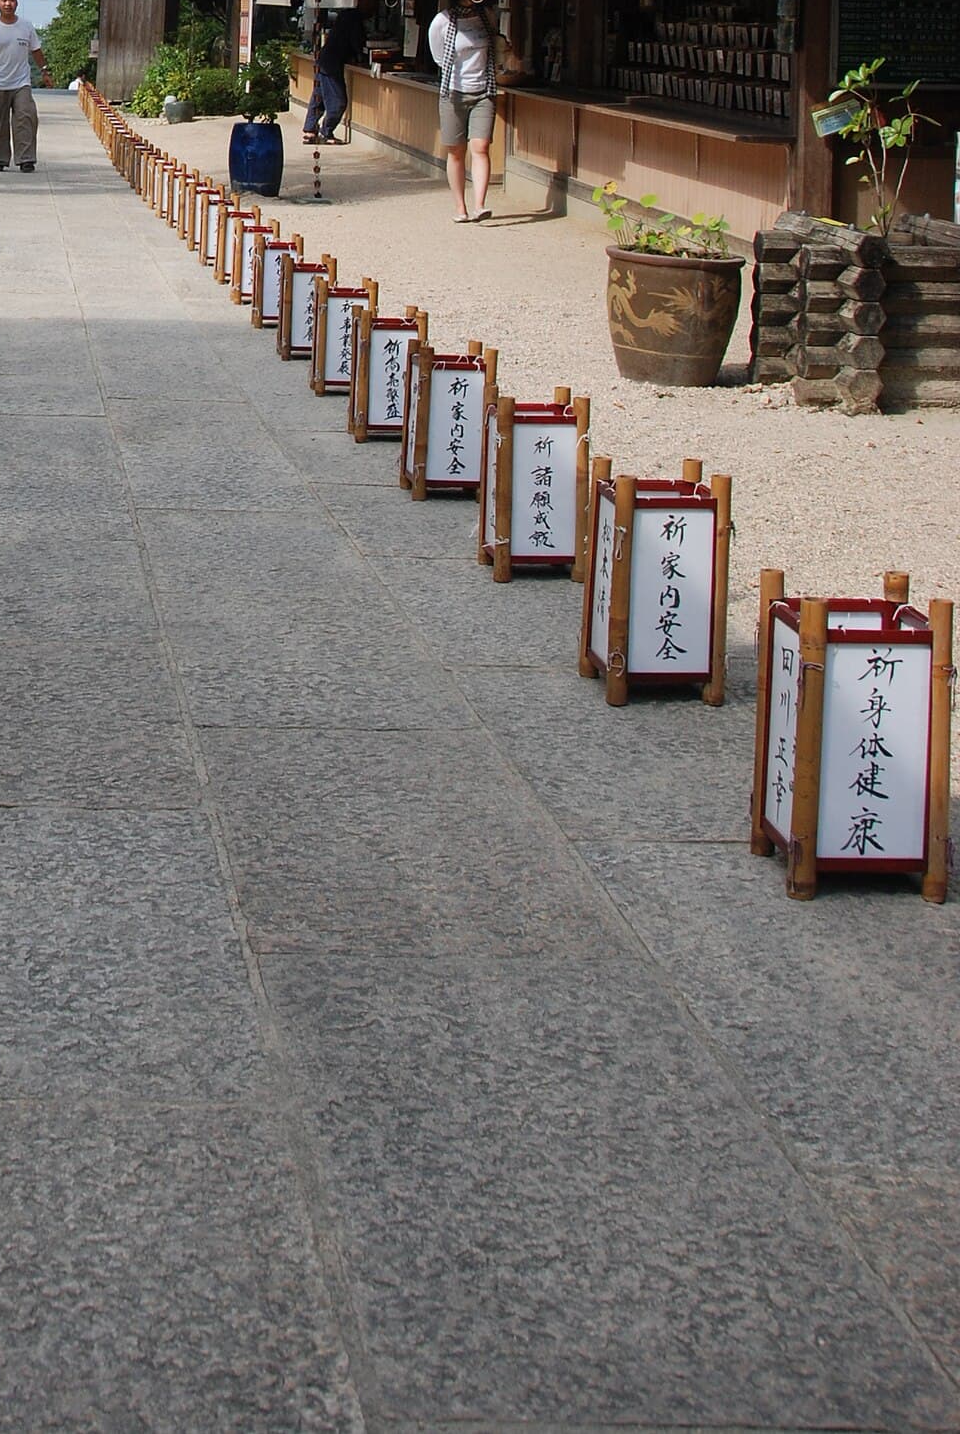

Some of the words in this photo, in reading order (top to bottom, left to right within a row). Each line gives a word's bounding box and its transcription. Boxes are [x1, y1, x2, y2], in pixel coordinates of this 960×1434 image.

[445, 377, 470, 474] 祈家内安全
[528, 437, 556, 549] 祈諸願成就
[654, 514, 688, 661] 祈家内安全
[840, 647, 903, 854] 祈身体健康
